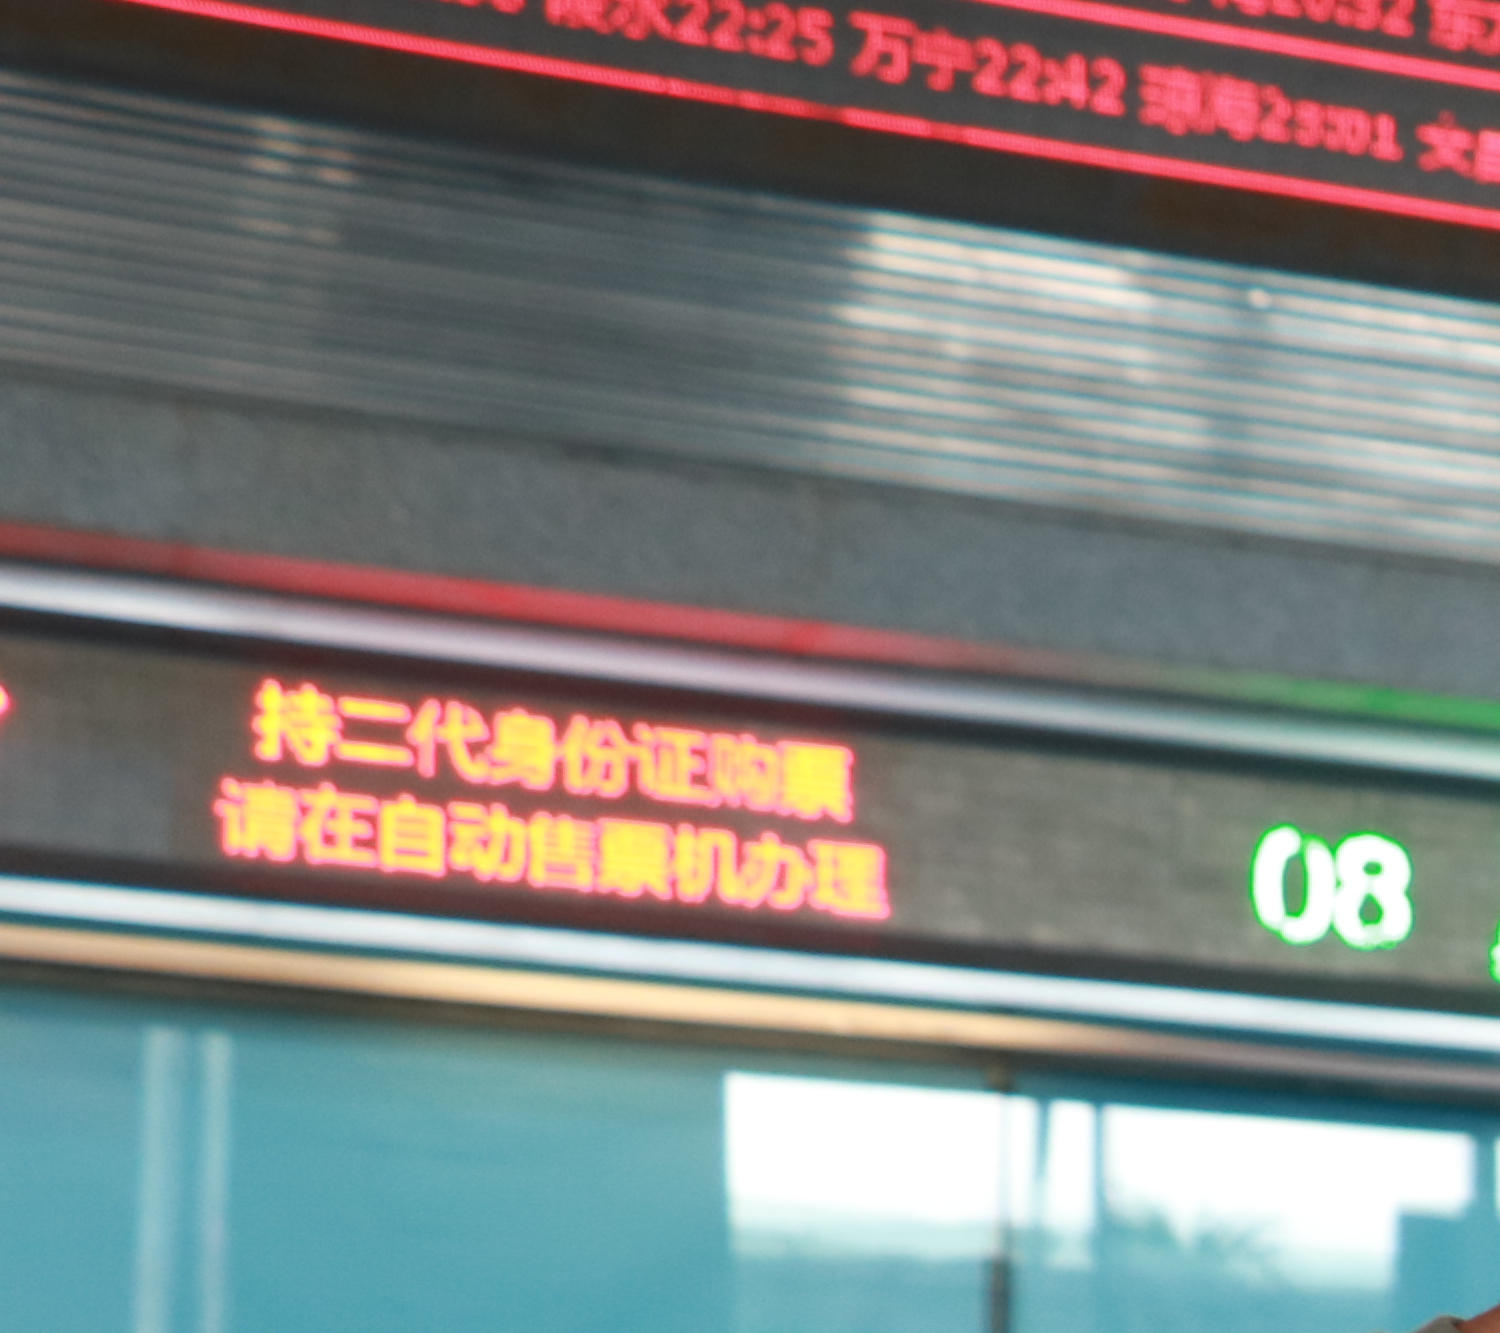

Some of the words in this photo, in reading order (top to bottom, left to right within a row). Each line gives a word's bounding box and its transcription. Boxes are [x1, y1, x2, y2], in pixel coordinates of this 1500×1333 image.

[850, 12, 1126, 116] 万宁22:42
[250, 679, 855, 823] 持二代身份证购票
[212, 776, 892, 921] 请在自动售票机办理
[1249, 823, 1414, 952] 08
